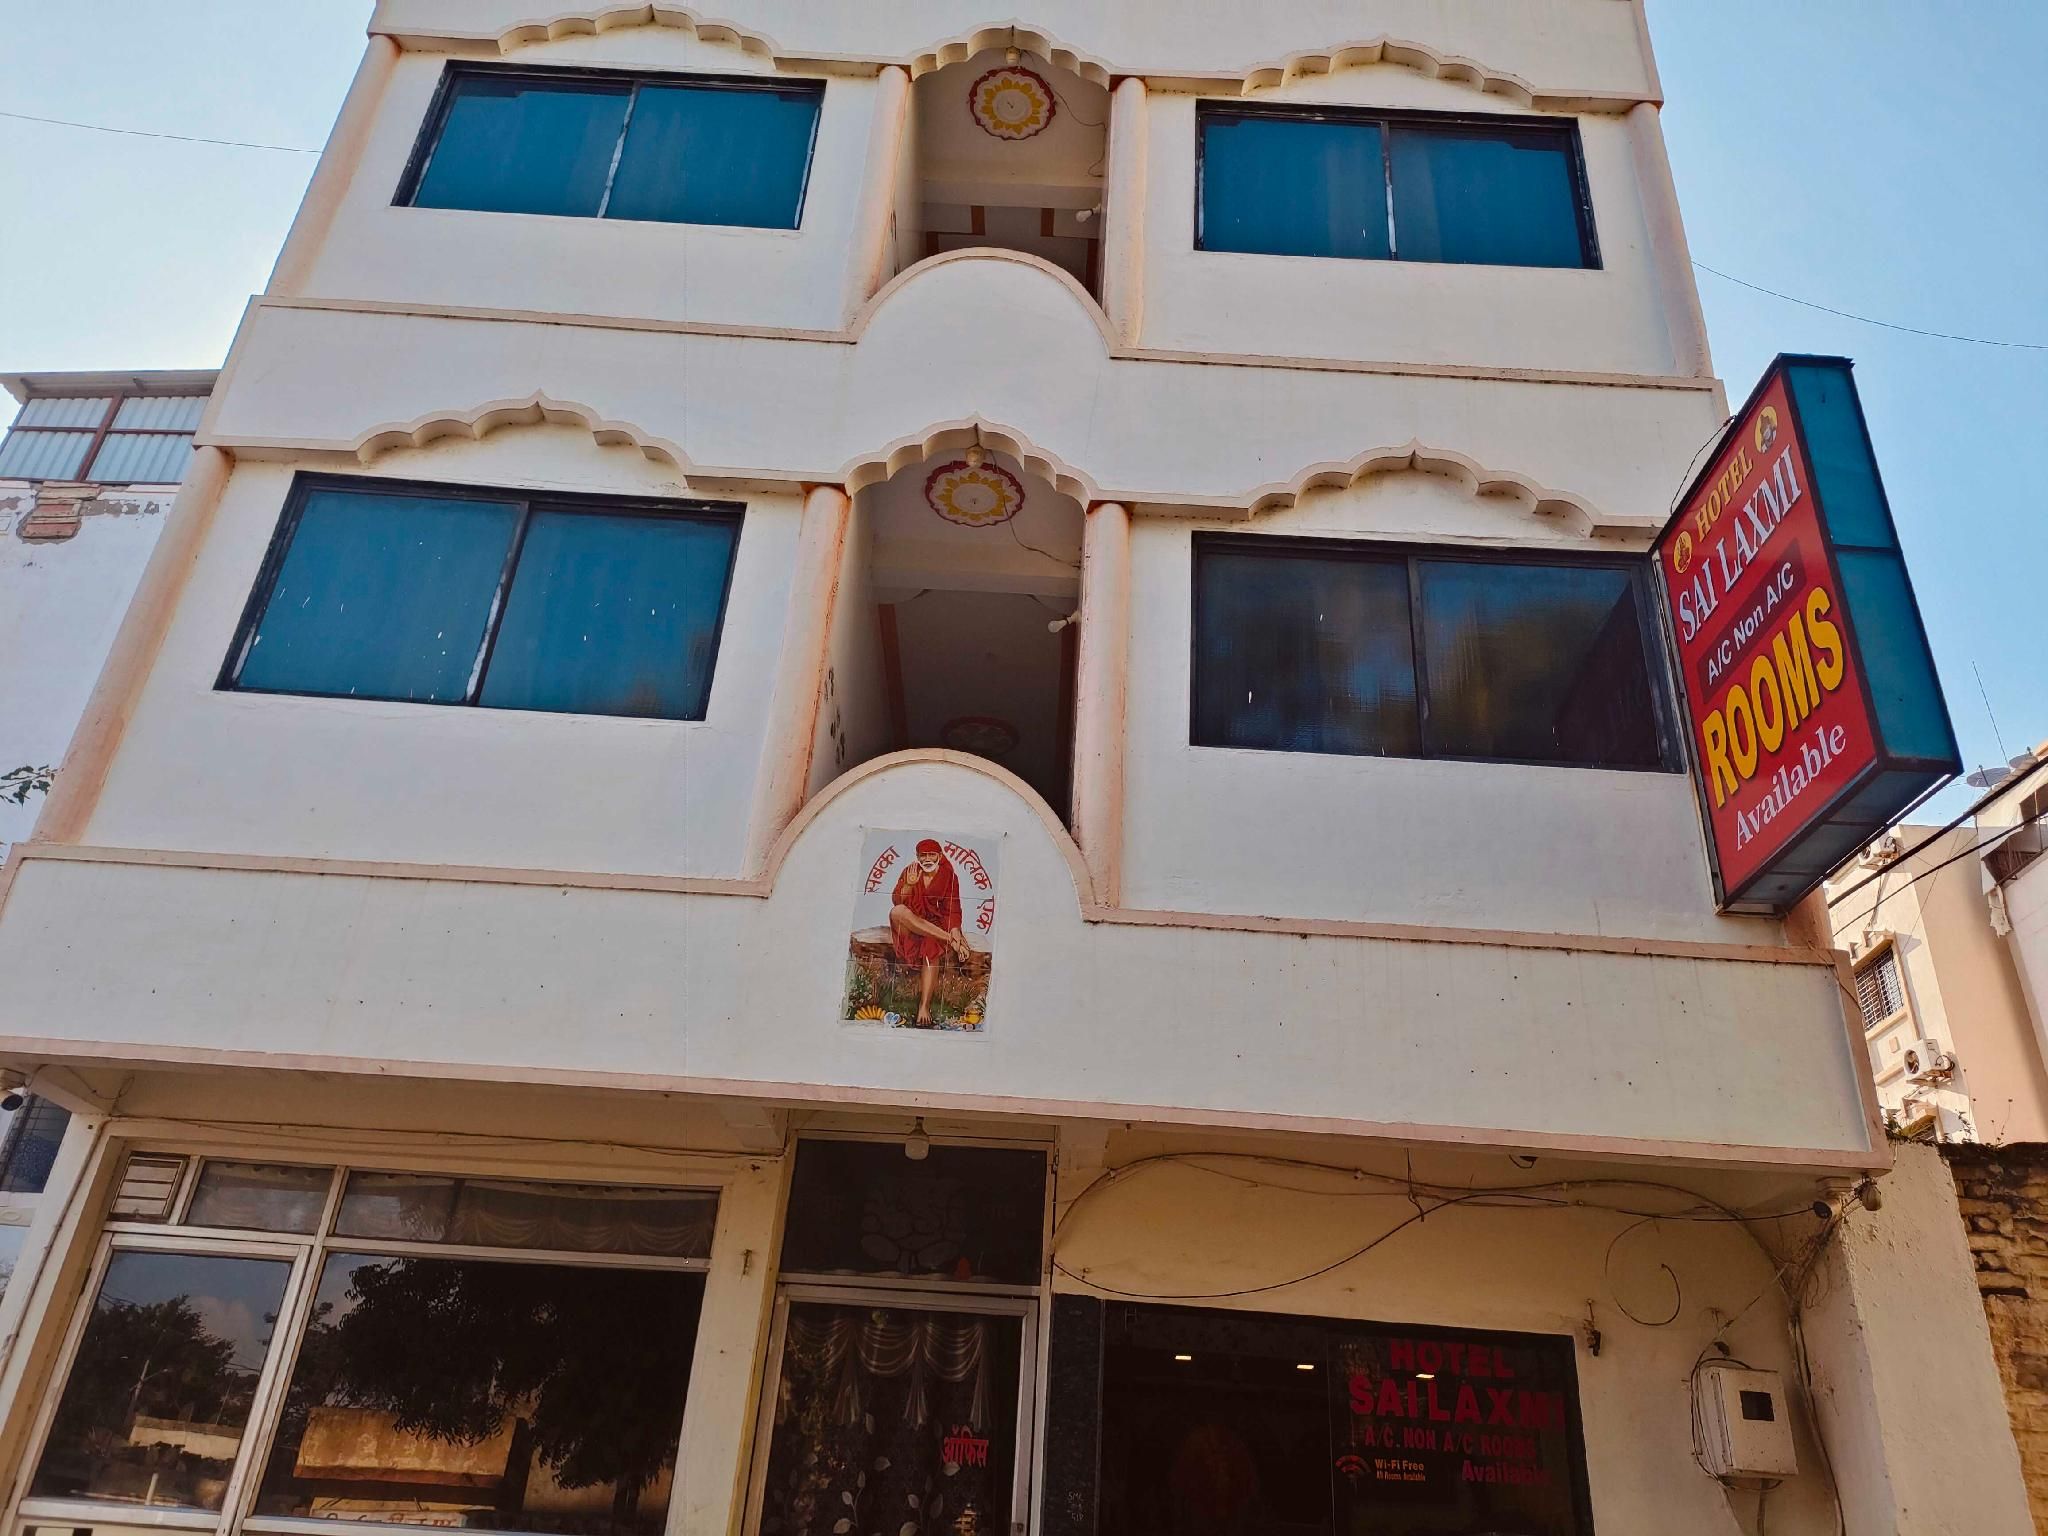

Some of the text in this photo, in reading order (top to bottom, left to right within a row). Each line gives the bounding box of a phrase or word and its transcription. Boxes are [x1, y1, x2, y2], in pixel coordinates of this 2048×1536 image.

[1679, 444, 1802, 643] SAI LAXMI
[1694, 446, 1753, 542] HOTEL
[1706, 561, 1795, 685] A/C Non A/C
[1702, 586, 1845, 809] ROOMS
[1735, 724, 1847, 850] Available
[1389, 1339, 1515, 1378] HOTEL
[1402, 1459, 1425, 1471] Free
